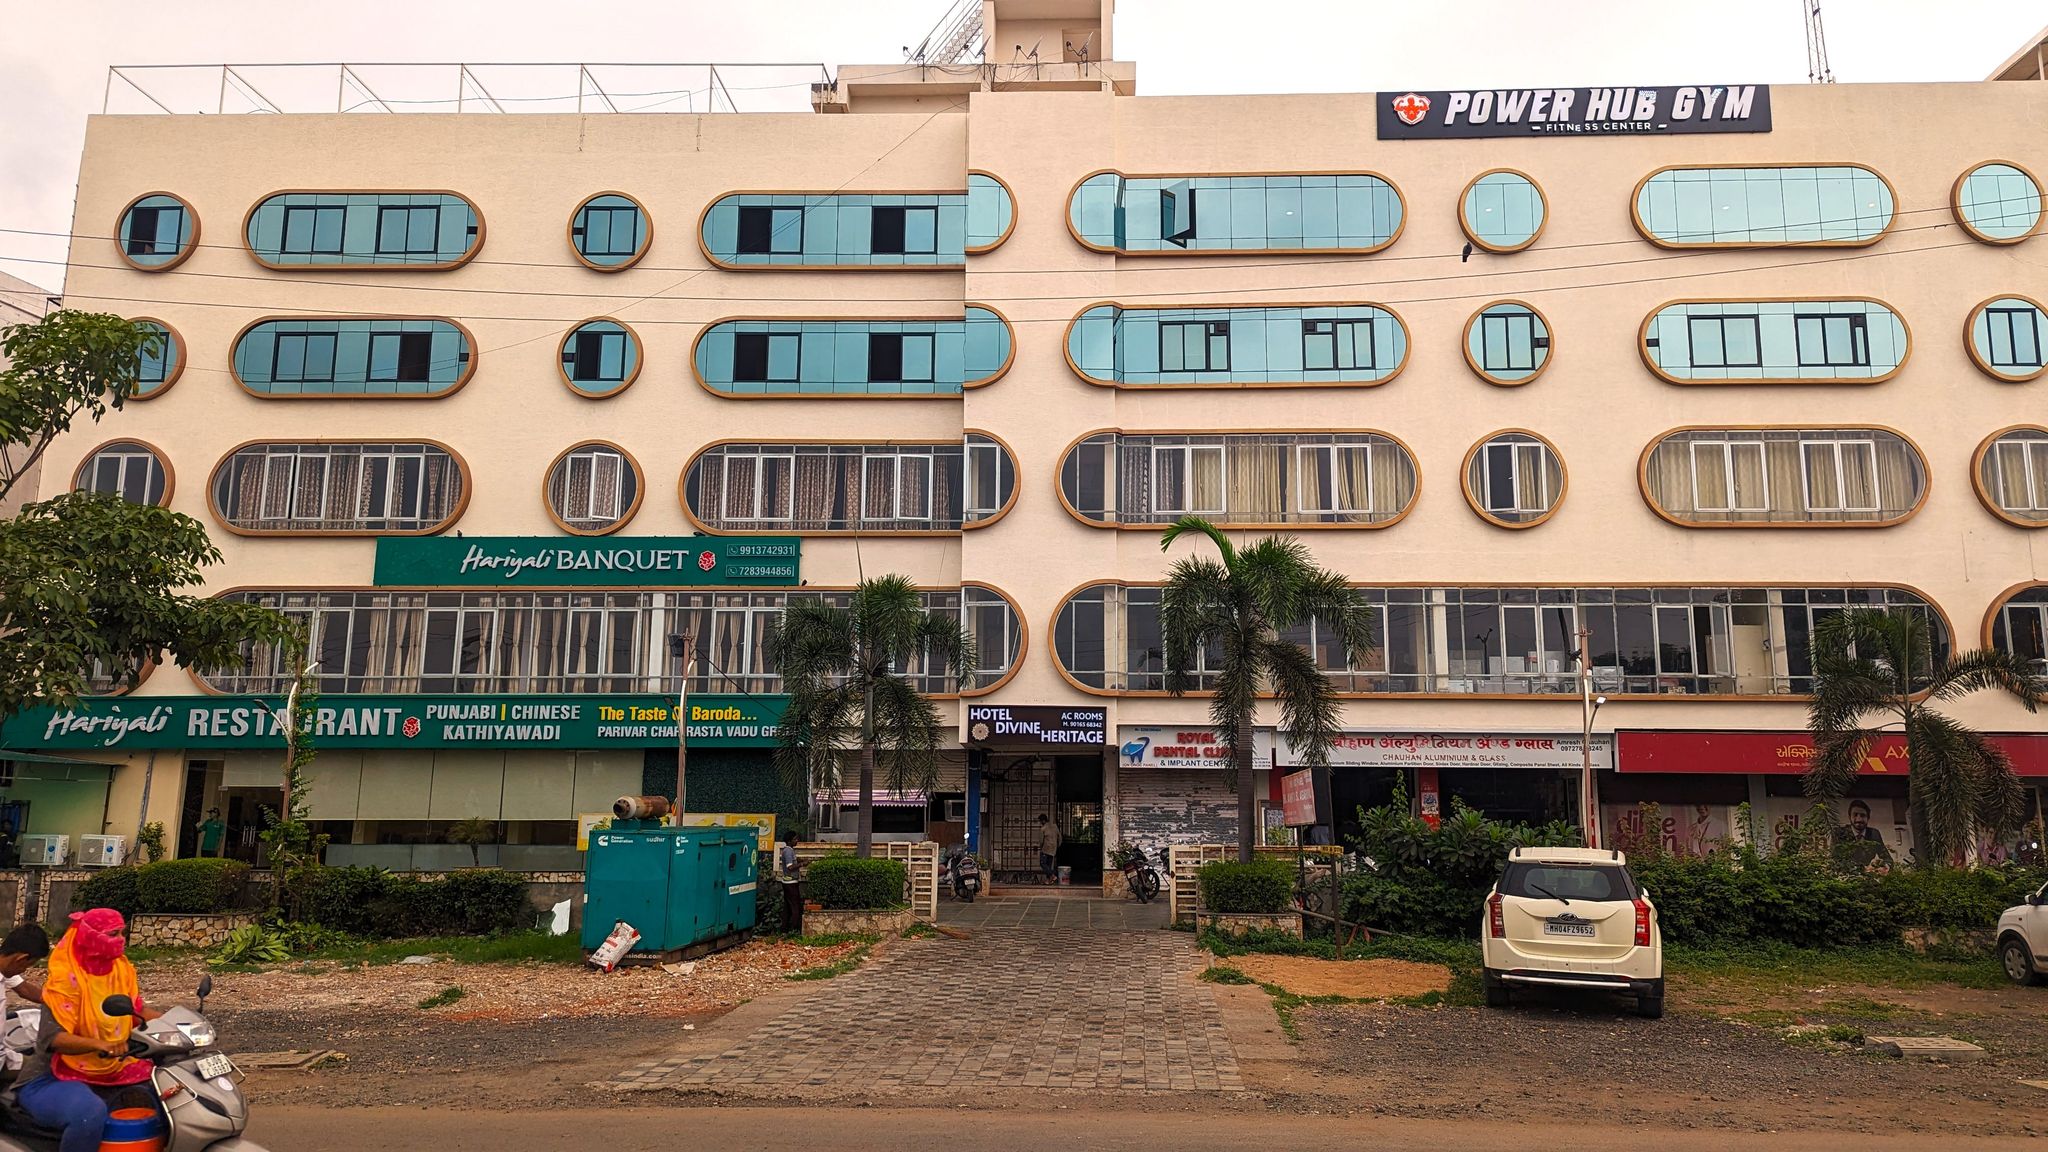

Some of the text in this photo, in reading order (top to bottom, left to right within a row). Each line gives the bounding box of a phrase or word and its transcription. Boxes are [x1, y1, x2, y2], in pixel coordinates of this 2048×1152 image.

[1444, 86, 1756, 125] POWER HUB GYM
[1602, 121, 1652, 131] CENTER
[739, 544, 794, 556] 9913742931
[460, 544, 689, 578] Hariyali BANQUET
[738, 565, 793, 577] 7283944856
[425, 705, 581, 720] PUNJABI CHINESE
[598, 706, 625, 720] The
[629, 706, 667, 720] Taste
[691, 706, 757, 720] Baroda...
[970, 708, 1012, 720] HOTEL
[1061, 712, 1103, 720] AC ROOMS
[43, 705, 172, 746] Hariyali
[597, 726, 647, 737] PARIVAR
[686, 726, 723, 737] RASTA
[727, 726, 758, 737] VADU
[995, 722, 1041, 734] DIVINE
[443, 725, 561, 740] KATHIYAWADI
[1040, 731, 1104, 743] HERITAGE
[1177, 732, 1217, 744] ROYAL
[1154, 746, 1200, 758] DENTAL
